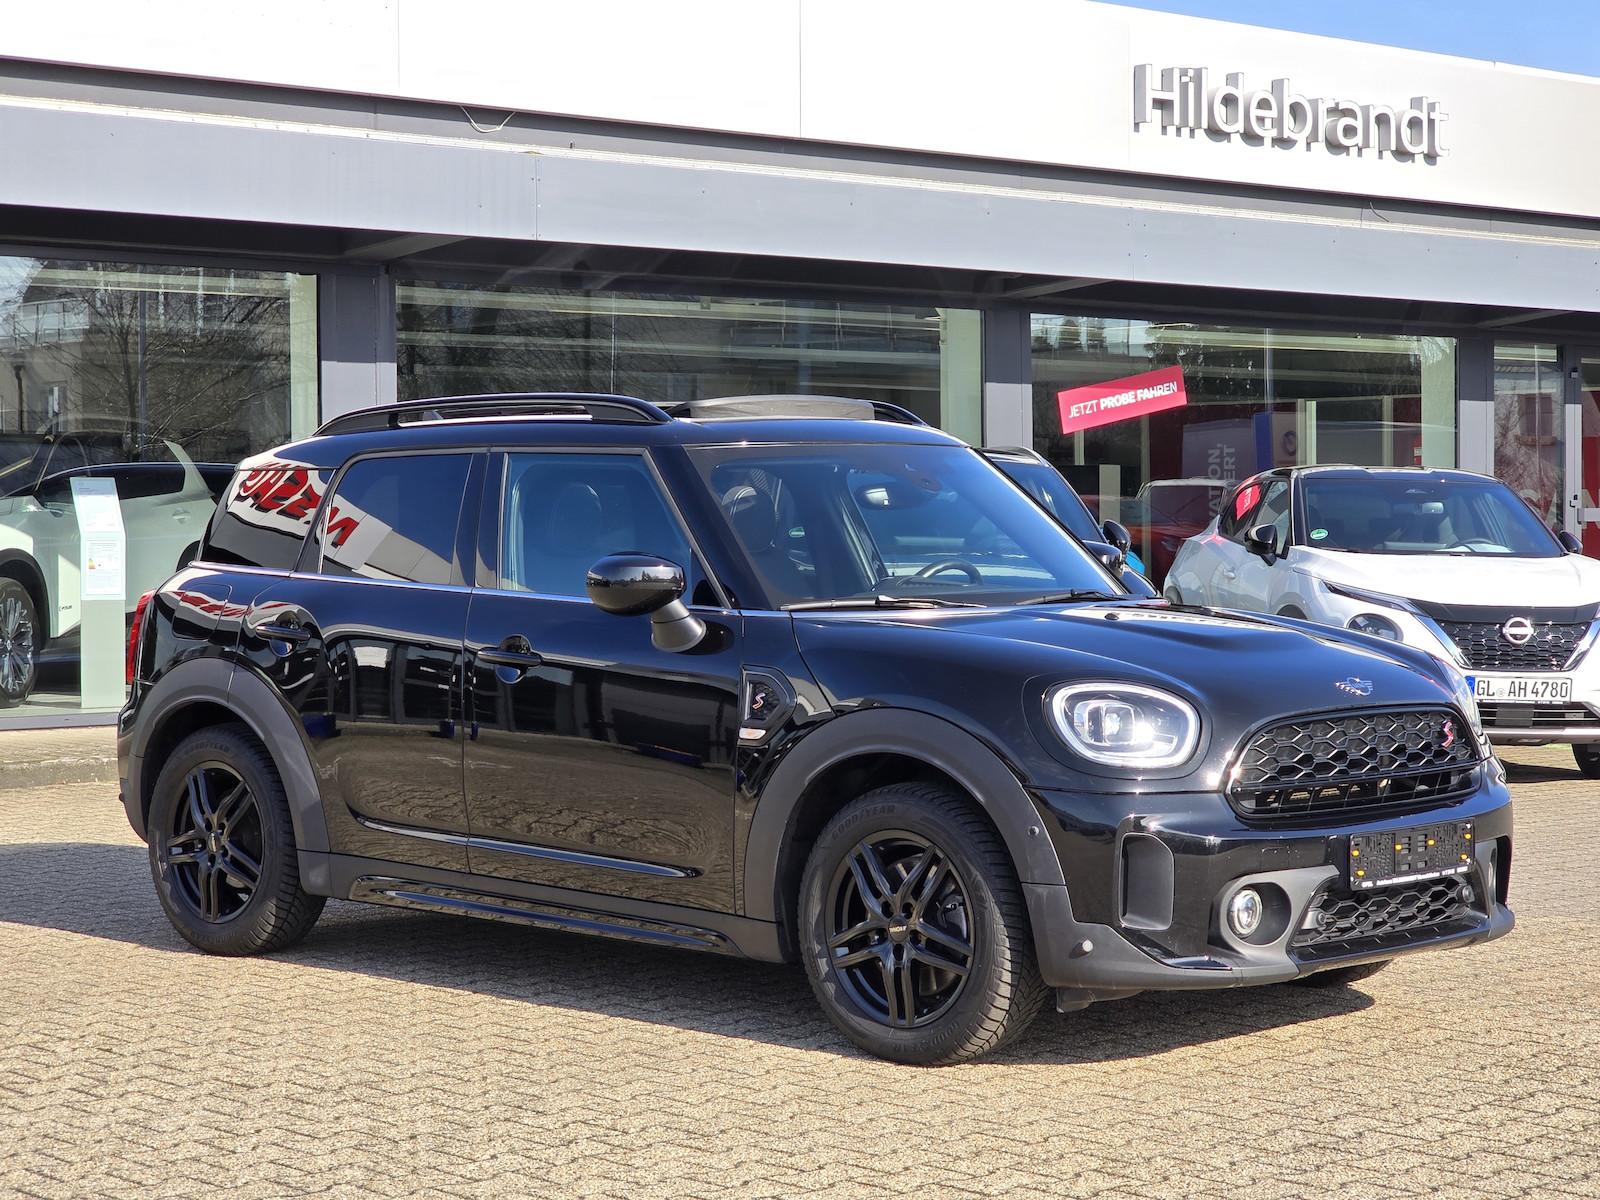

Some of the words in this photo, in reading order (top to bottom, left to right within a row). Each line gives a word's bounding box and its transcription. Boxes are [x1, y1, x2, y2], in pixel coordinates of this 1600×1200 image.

[1133, 63, 1450, 162] Hildebrandt
[1069, 400, 1098, 418] JETZT
[1100, 391, 1136, 410] PROBE
[1137, 381, 1178, 401] FAHREN
[1476, 680, 1495, 697] GL
[1508, 681, 1527, 697] AH
[1531, 681, 1568, 698] 4780
